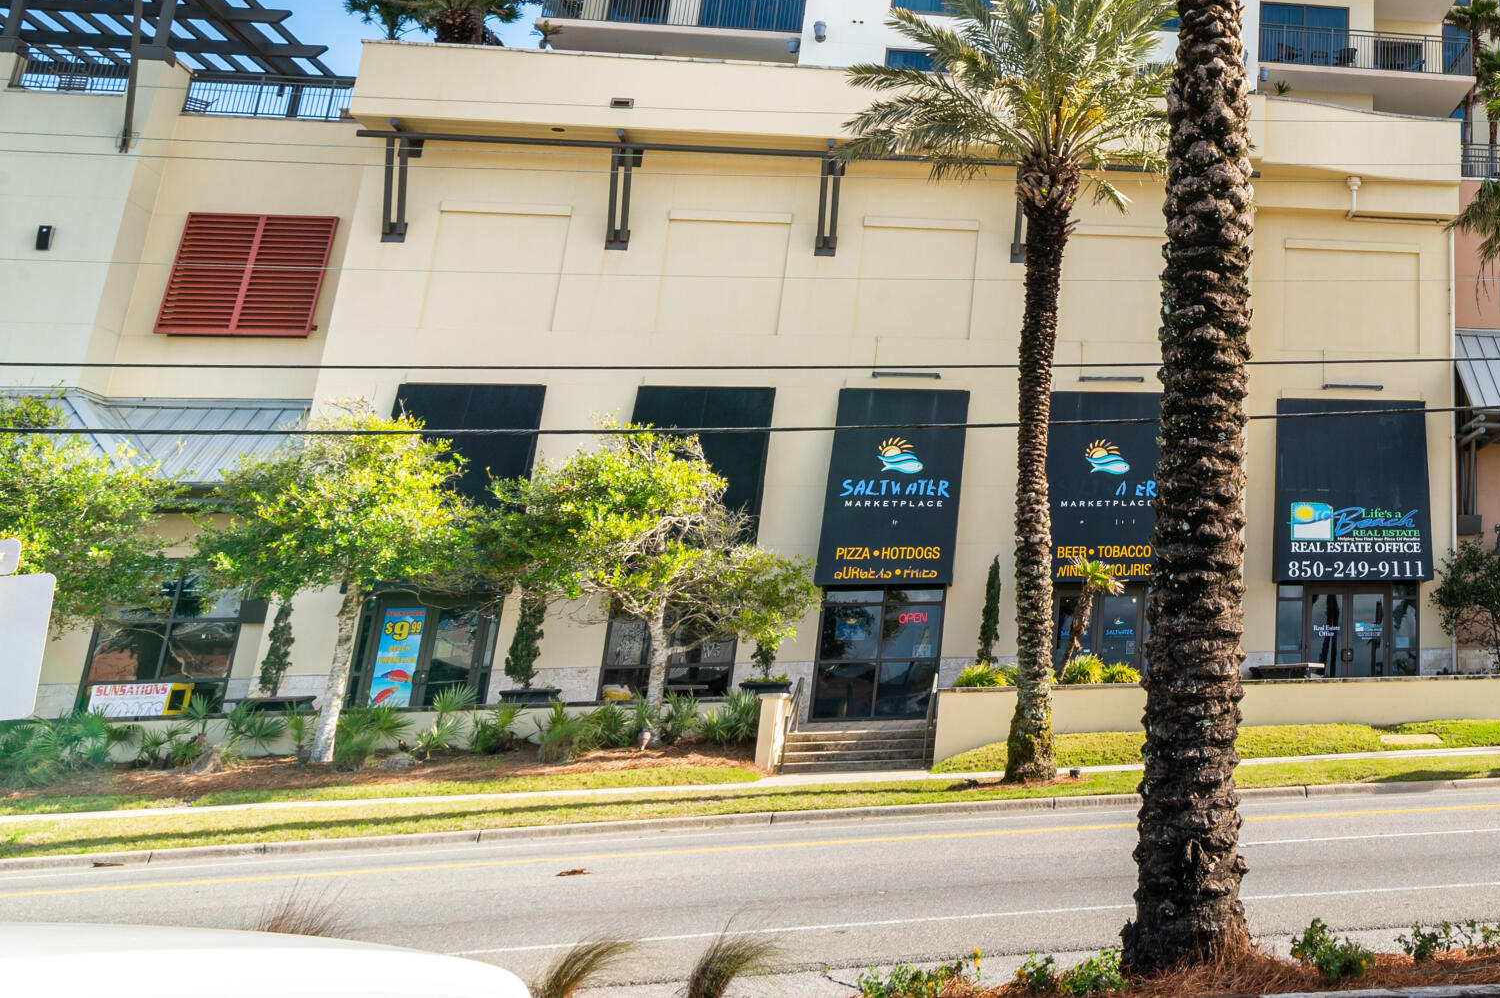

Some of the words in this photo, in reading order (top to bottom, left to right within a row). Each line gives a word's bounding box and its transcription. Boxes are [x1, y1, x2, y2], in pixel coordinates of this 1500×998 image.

[1362, 508, 1392, 518] Life's
[1333, 507, 1419, 536] Beach
[1352, 529, 1381, 537] REAL
[1382, 529, 1420, 537] ESTATE
[835, 547, 871, 560] PIZZA
[881, 546, 941, 560] HOTDOGS
[1057, 546, 1087, 558] BEER
[1097, 545, 1152, 558] TOBACCO
[1291, 542, 1325, 553] REAL
[1326, 542, 1373, 553] ESTATE
[1374, 542, 1422, 553] OFFICE
[1288, 561, 1425, 578] 850-249-9111
[898, 612, 928, 624] OPEN
[95, 684, 168, 697] SUNSATIONS
